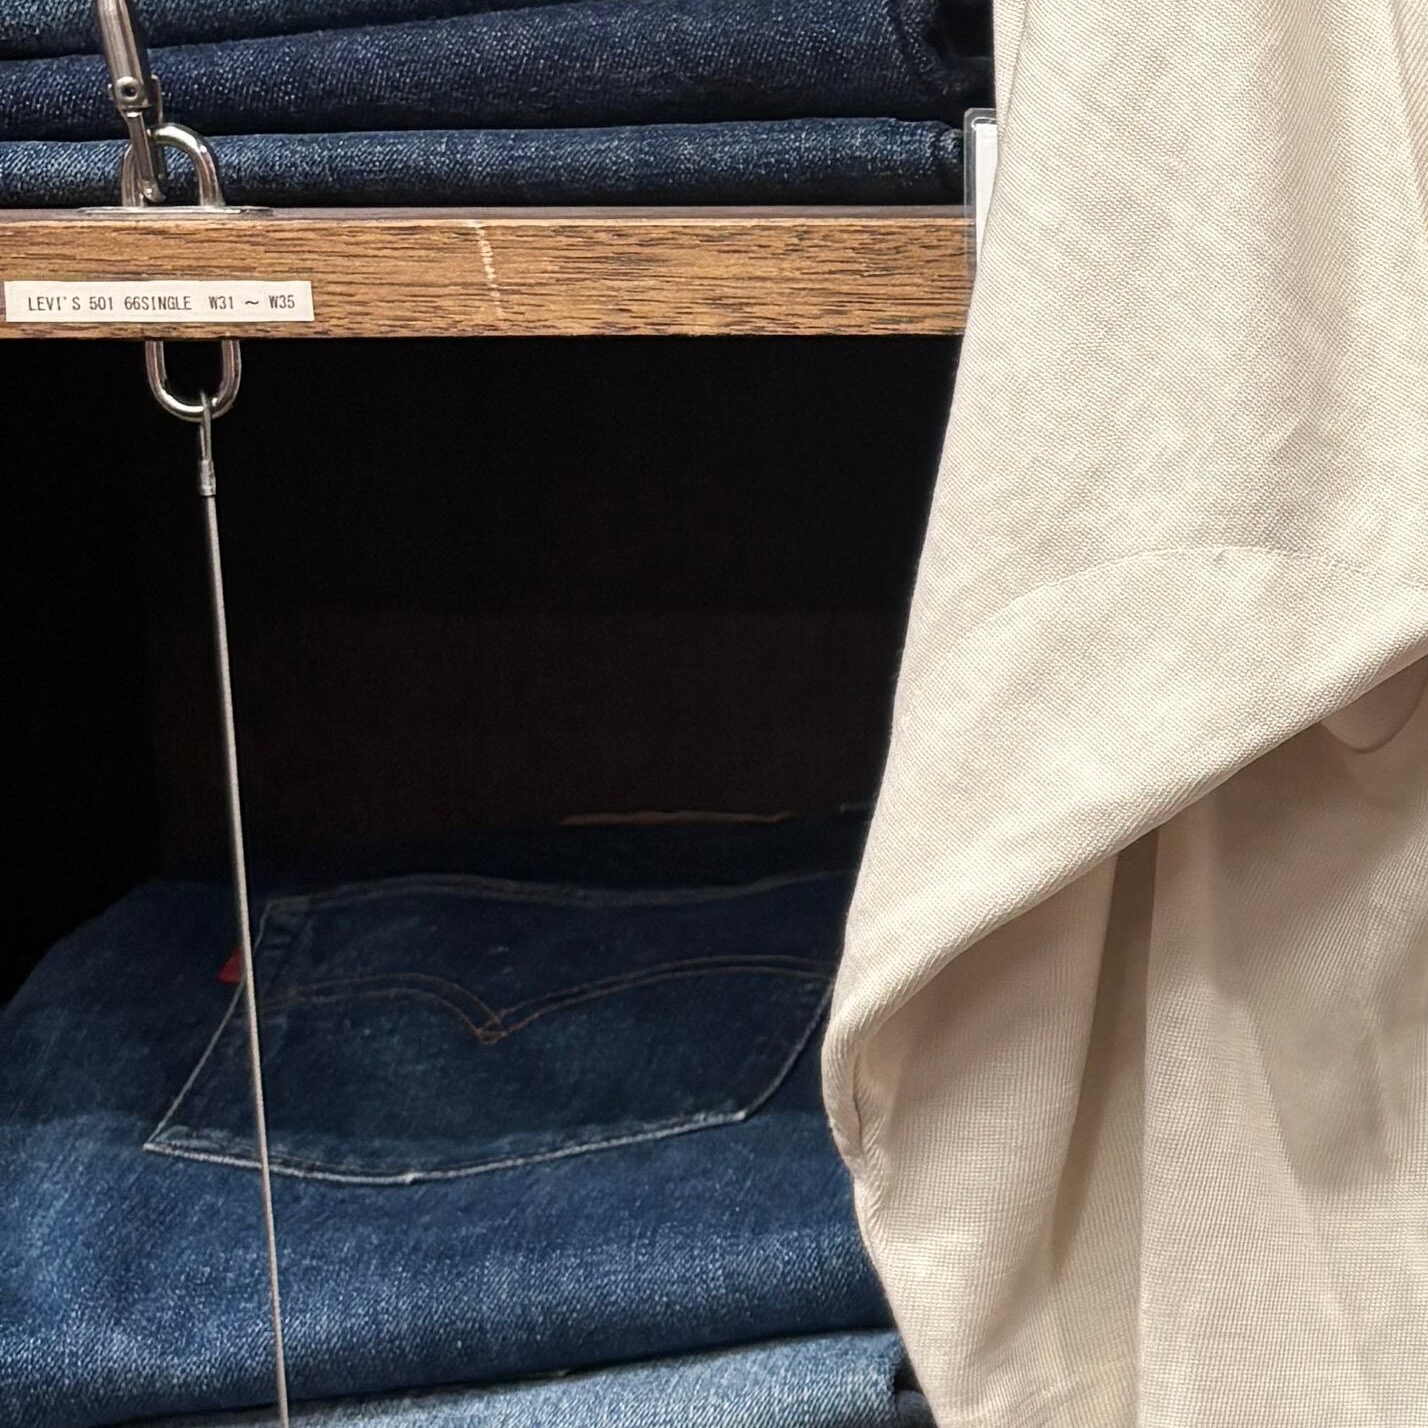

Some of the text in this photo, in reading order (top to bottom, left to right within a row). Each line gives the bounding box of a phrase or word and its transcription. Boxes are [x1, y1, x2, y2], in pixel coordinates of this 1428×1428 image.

[27, 295, 81, 312] LEVI'S
[88, 295, 114, 311] 501
[123, 295, 193, 311] 66SINGLE
[207, 295, 234, 311] W31
[268, 294, 296, 310] W35
